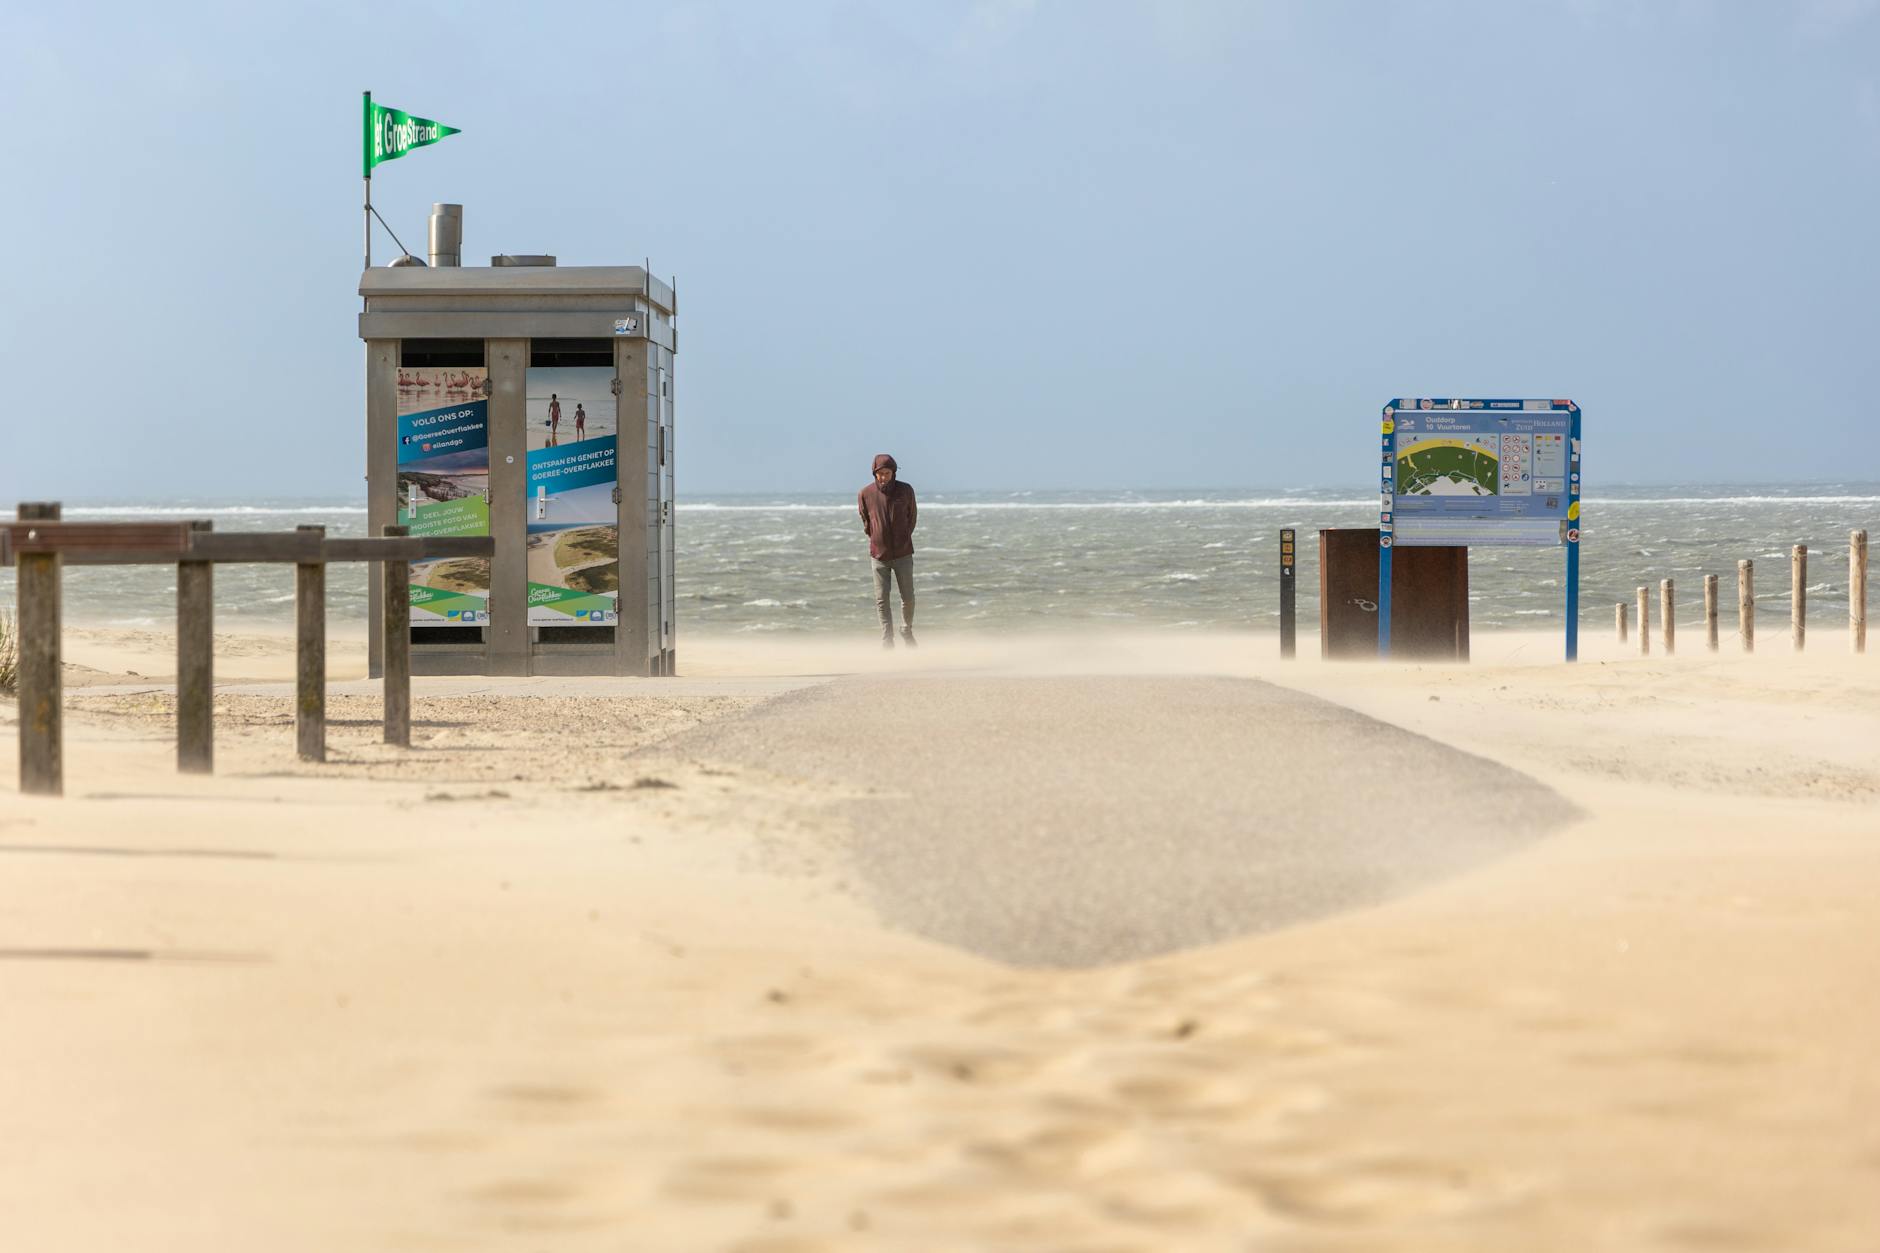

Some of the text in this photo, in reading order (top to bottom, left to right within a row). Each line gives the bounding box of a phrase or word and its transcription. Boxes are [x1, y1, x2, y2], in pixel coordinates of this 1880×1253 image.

[411, 410, 474, 427] VOLG ONS OP:
[1425, 416, 1456, 424] Ouddorp
[412, 423, 484, 442] @GoereeOverflakkee
[532, 448, 615, 471] ONTSPAN EN GENIET OP
[532, 458, 615, 481] GOEREE-OVERFLAKKEE
[423, 506, 464, 519] DEEL JOUW
[410, 513, 478, 531] MOOISTE FOTO VAN
